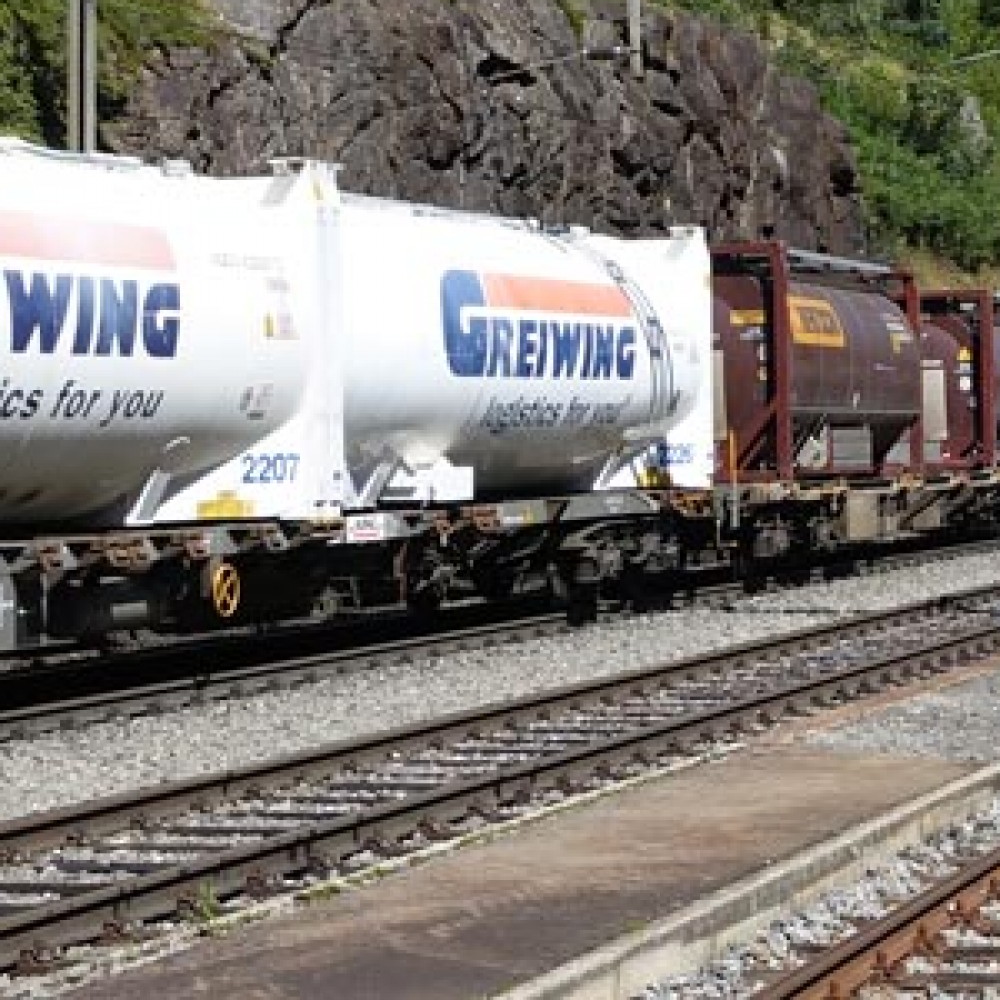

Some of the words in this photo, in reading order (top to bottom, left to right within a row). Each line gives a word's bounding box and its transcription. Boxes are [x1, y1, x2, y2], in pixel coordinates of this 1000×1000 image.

[440, 269, 636, 380] GREIWING
[50, 379, 101, 419] for
[100, 389, 165, 427] you
[242, 453, 301, 484] 2207
